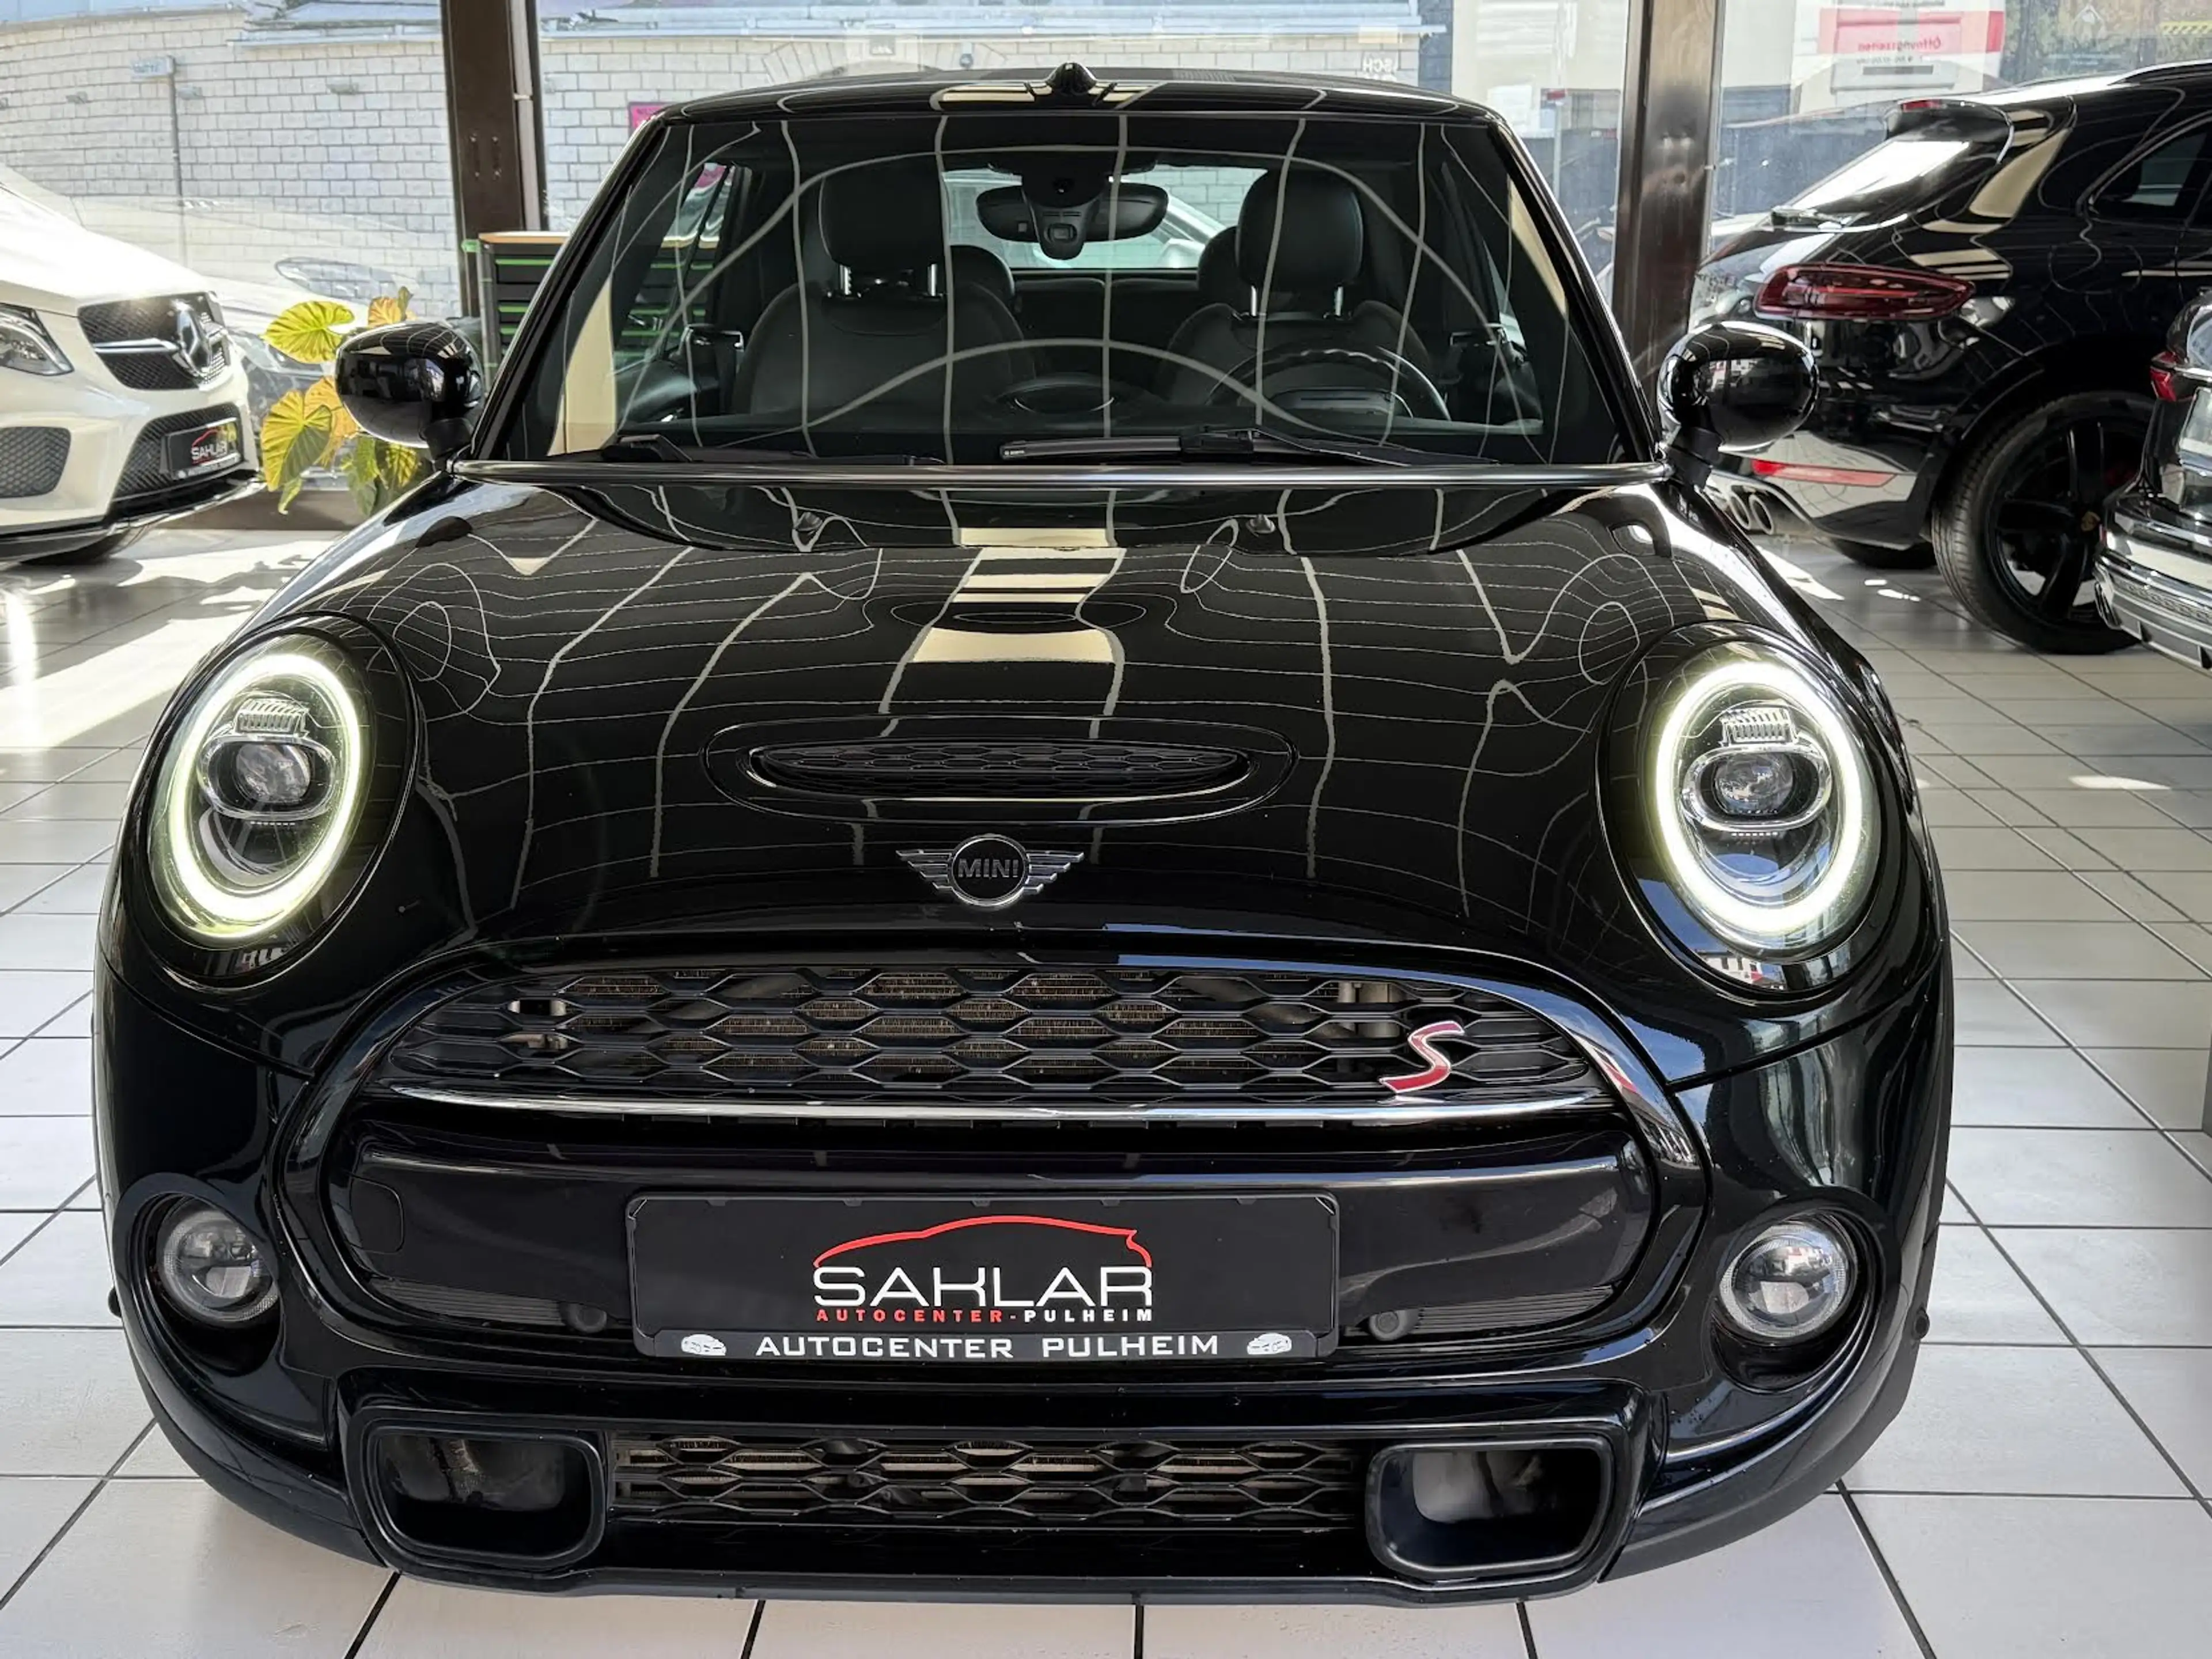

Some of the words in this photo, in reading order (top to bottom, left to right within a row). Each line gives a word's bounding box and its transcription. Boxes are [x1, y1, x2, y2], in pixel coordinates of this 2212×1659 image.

[957, 858, 1019, 878] MINI
[1378, 1020, 1465, 1093] S
[813, 1266, 1153, 1307] SAKLAR
[755, 1336, 1014, 1359] AUTOCENTER
[1041, 1335, 1218, 1358] PULHEIM
